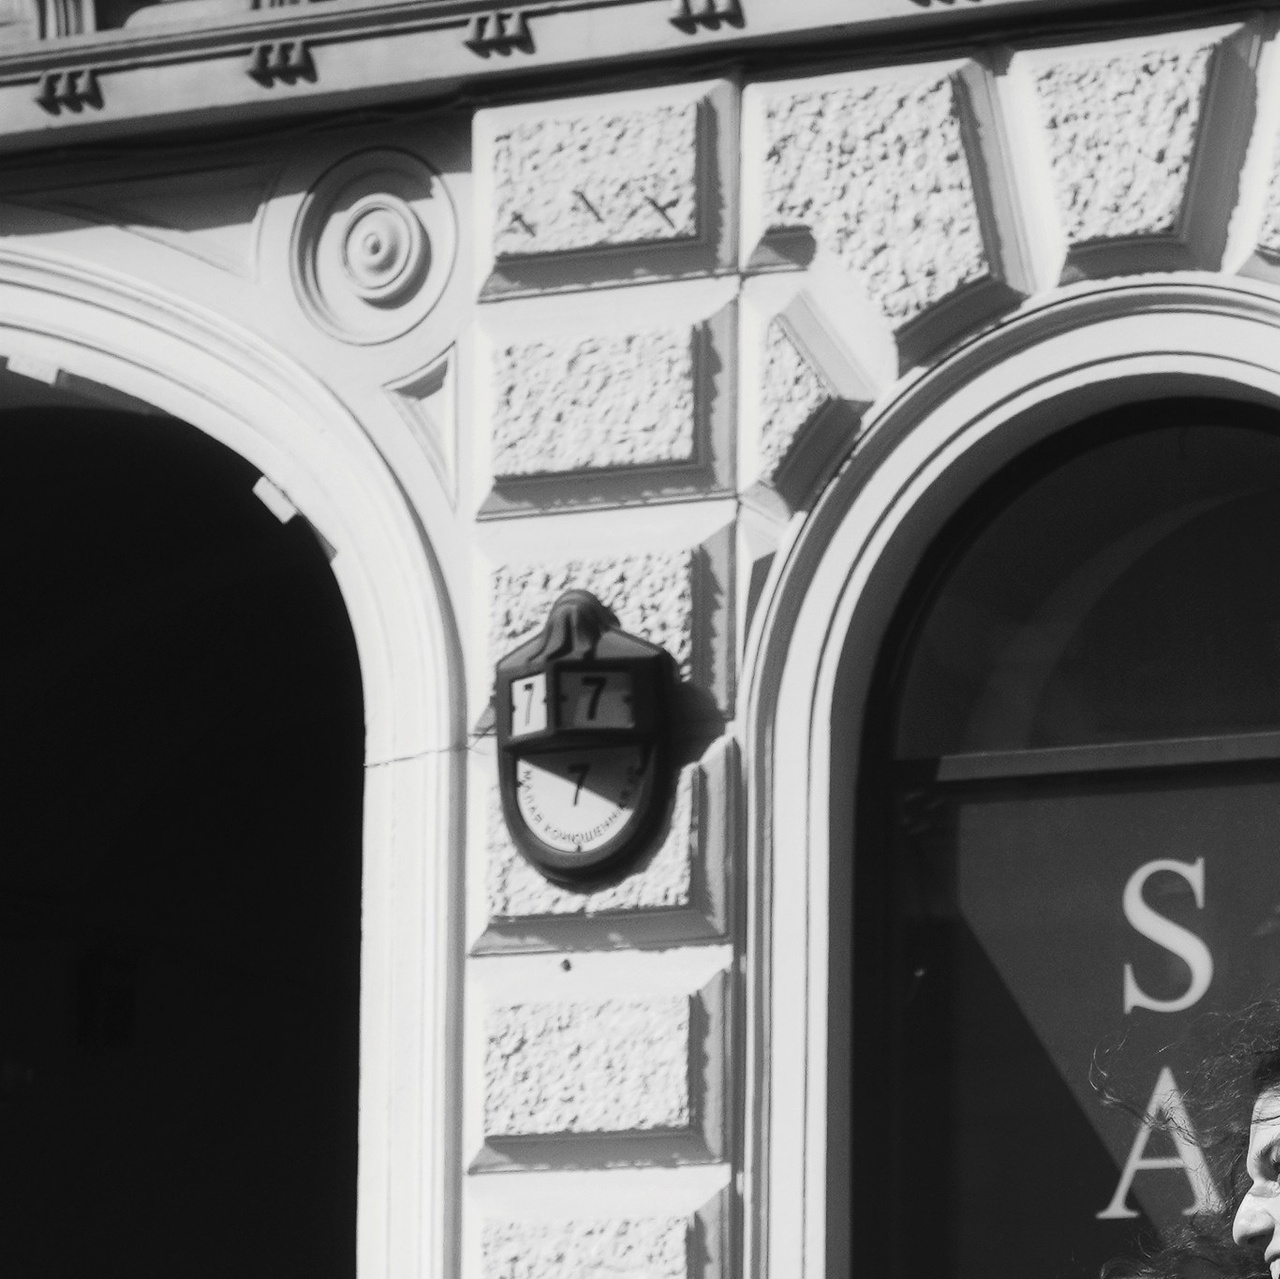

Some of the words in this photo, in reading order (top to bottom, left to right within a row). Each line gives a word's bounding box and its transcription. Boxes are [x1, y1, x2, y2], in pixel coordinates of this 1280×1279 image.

[524, 683, 534, 727] 7
[581, 676, 606, 721] 7
[568, 763, 591, 807] 7
